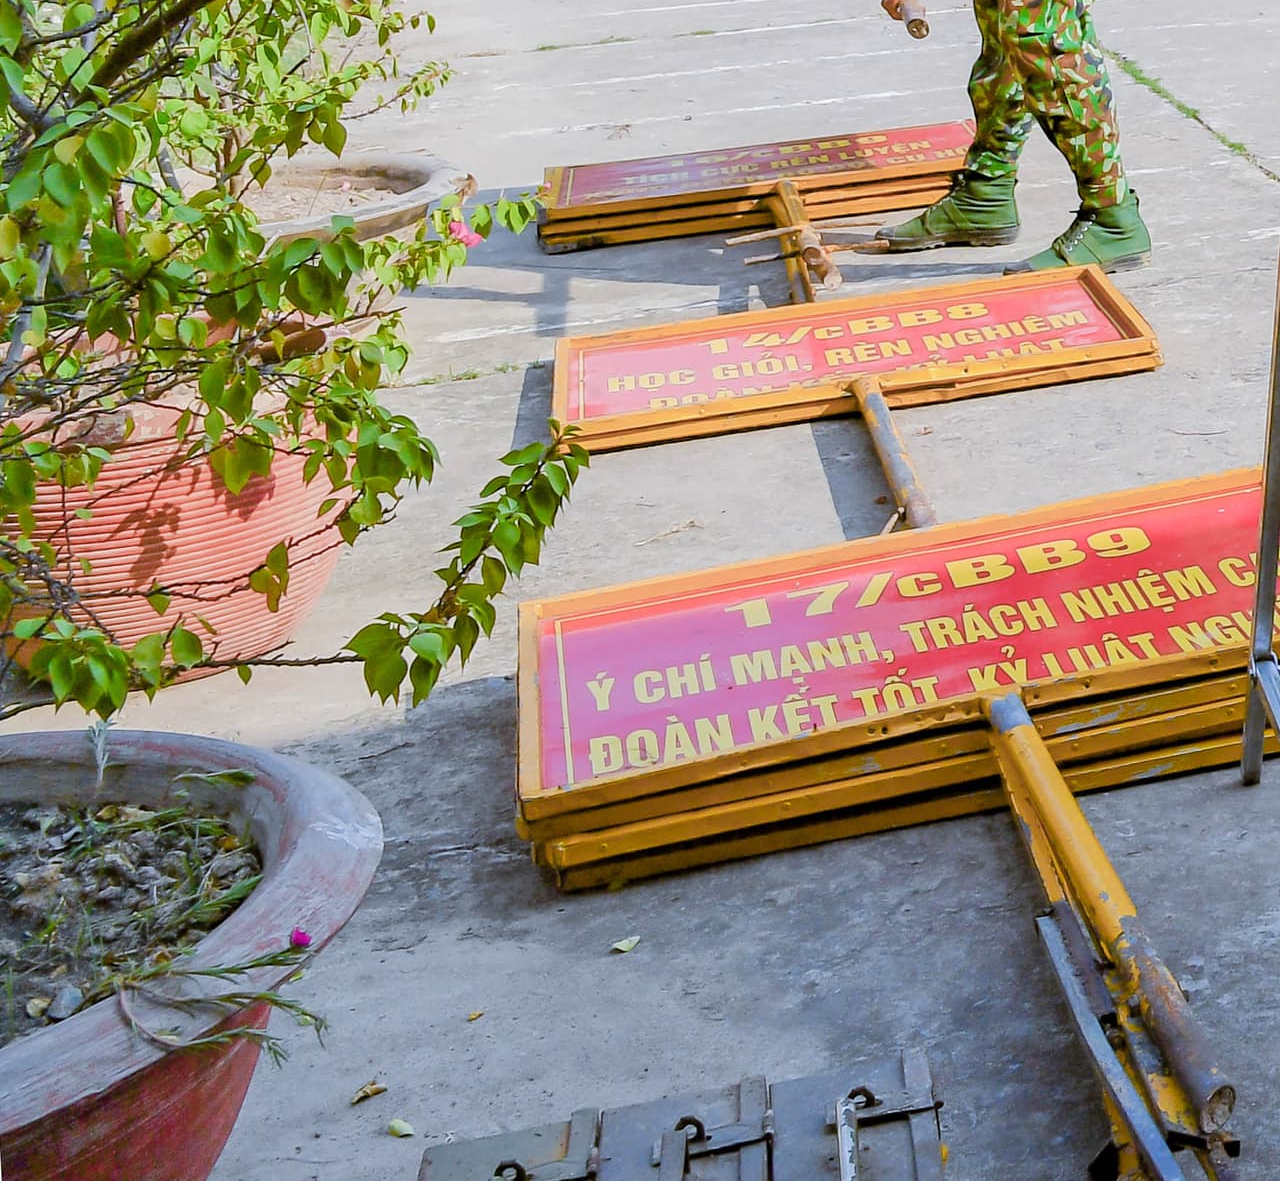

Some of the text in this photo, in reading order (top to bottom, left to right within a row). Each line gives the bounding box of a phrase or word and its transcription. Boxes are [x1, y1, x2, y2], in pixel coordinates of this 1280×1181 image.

[839, 140, 932, 161] LUYỆN
[606, 367, 696, 395] HỌC
[713, 348, 813, 381] GIỎI,
[823, 338, 913, 367] RÈN
[921, 308, 1090, 352] NGHIÊM
[699, 302, 989, 356] 14/cBB8
[724, 526, 1153, 629] 17/cBB9
[585, 671, 616, 713] Ý
[632, 652, 718, 706] CHÍ
[729, 630, 896, 687] MẠNH,
[898, 596, 1059, 654] TRÁCH
[1059, 564, 1217, 621] NHIỆM
[588, 713, 736, 775] ĐOÀN
[748, 684, 839, 742] KẾT
